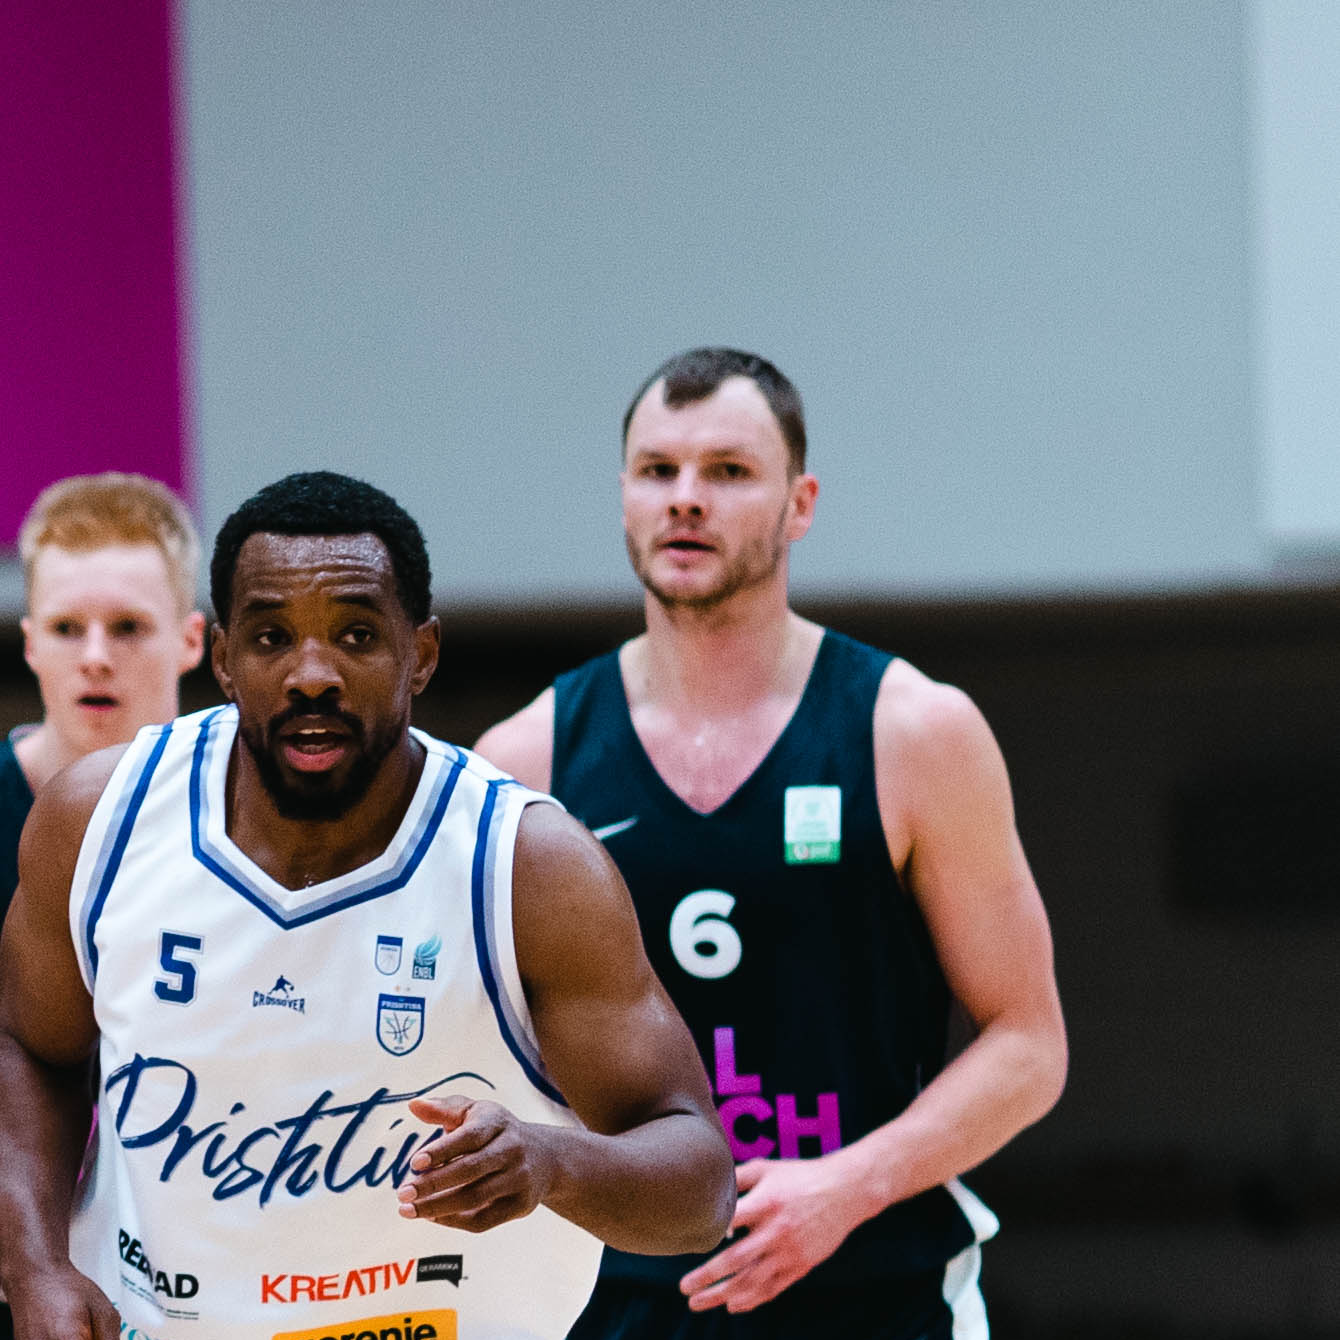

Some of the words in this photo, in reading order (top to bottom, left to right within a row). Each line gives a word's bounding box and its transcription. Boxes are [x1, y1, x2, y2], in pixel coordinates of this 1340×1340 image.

[153, 928, 205, 1007] 5
[669, 889, 743, 979] 6
[717, 1092, 842, 1161] CH
[260, 1258, 416, 1303] KREATIV
